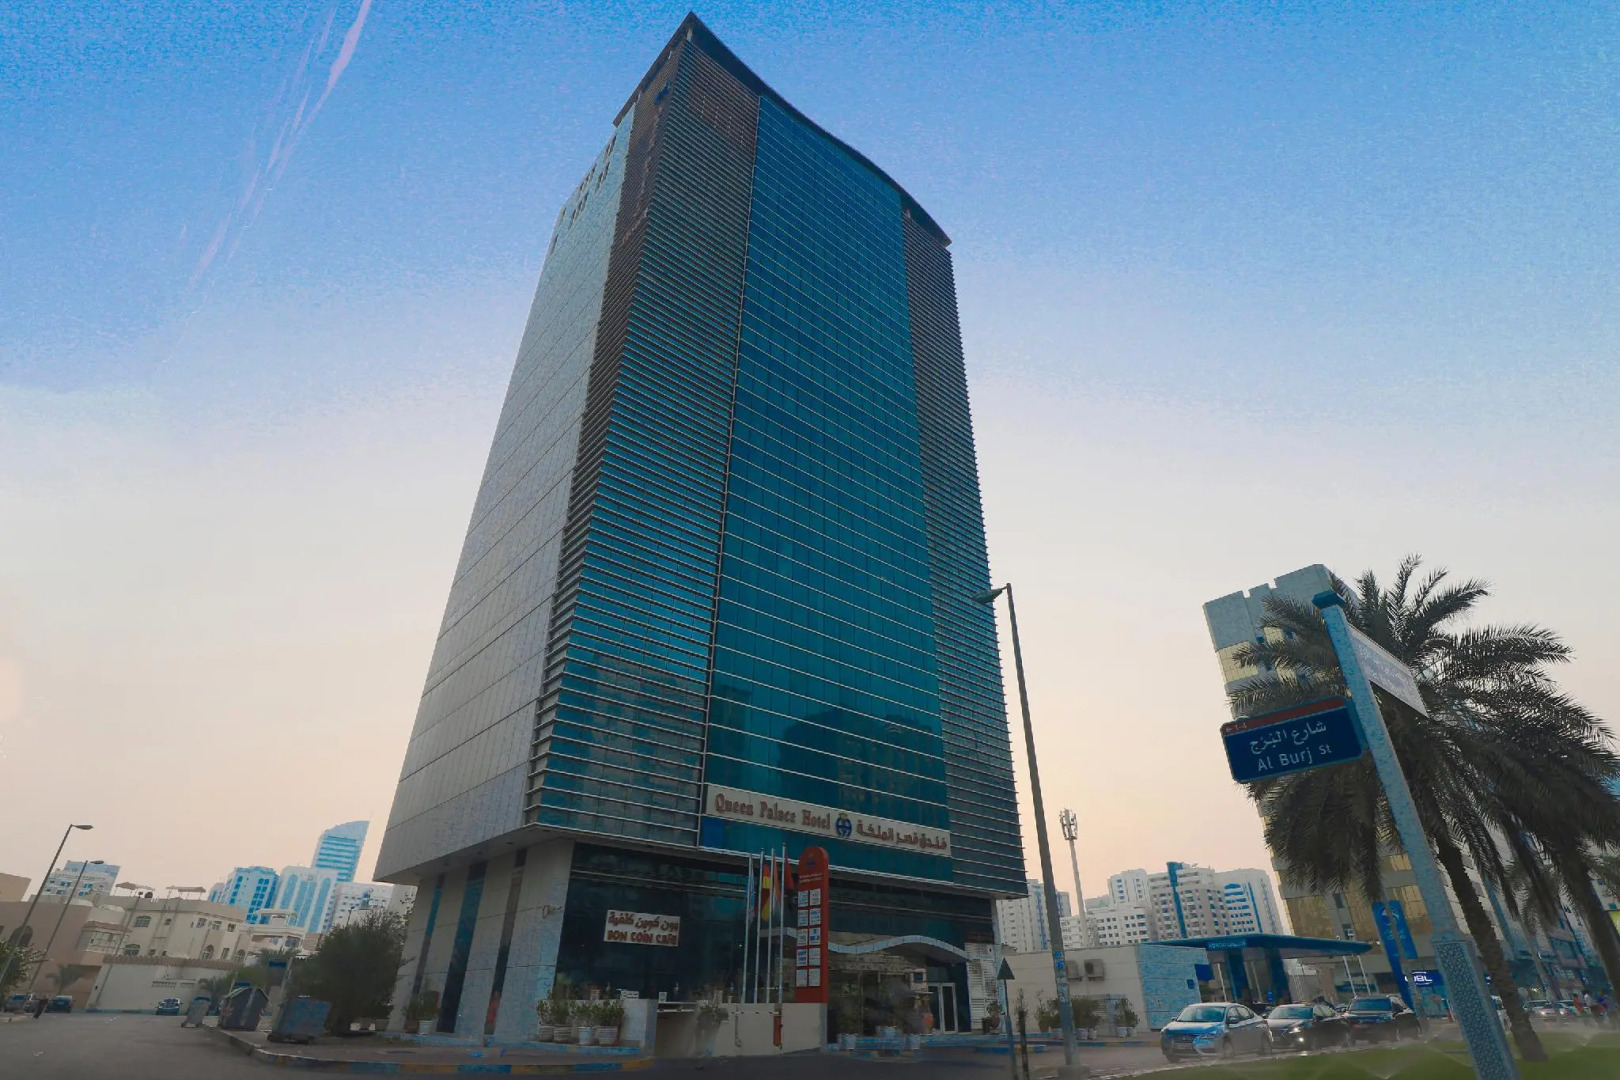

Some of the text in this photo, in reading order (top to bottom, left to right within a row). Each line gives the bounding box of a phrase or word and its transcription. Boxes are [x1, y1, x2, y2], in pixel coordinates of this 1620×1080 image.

[1291, 720, 1327, 746] شارع
[1257, 744, 1332, 772] Al Burj St
[714, 792, 831, 830] Queen Palace Hotel
